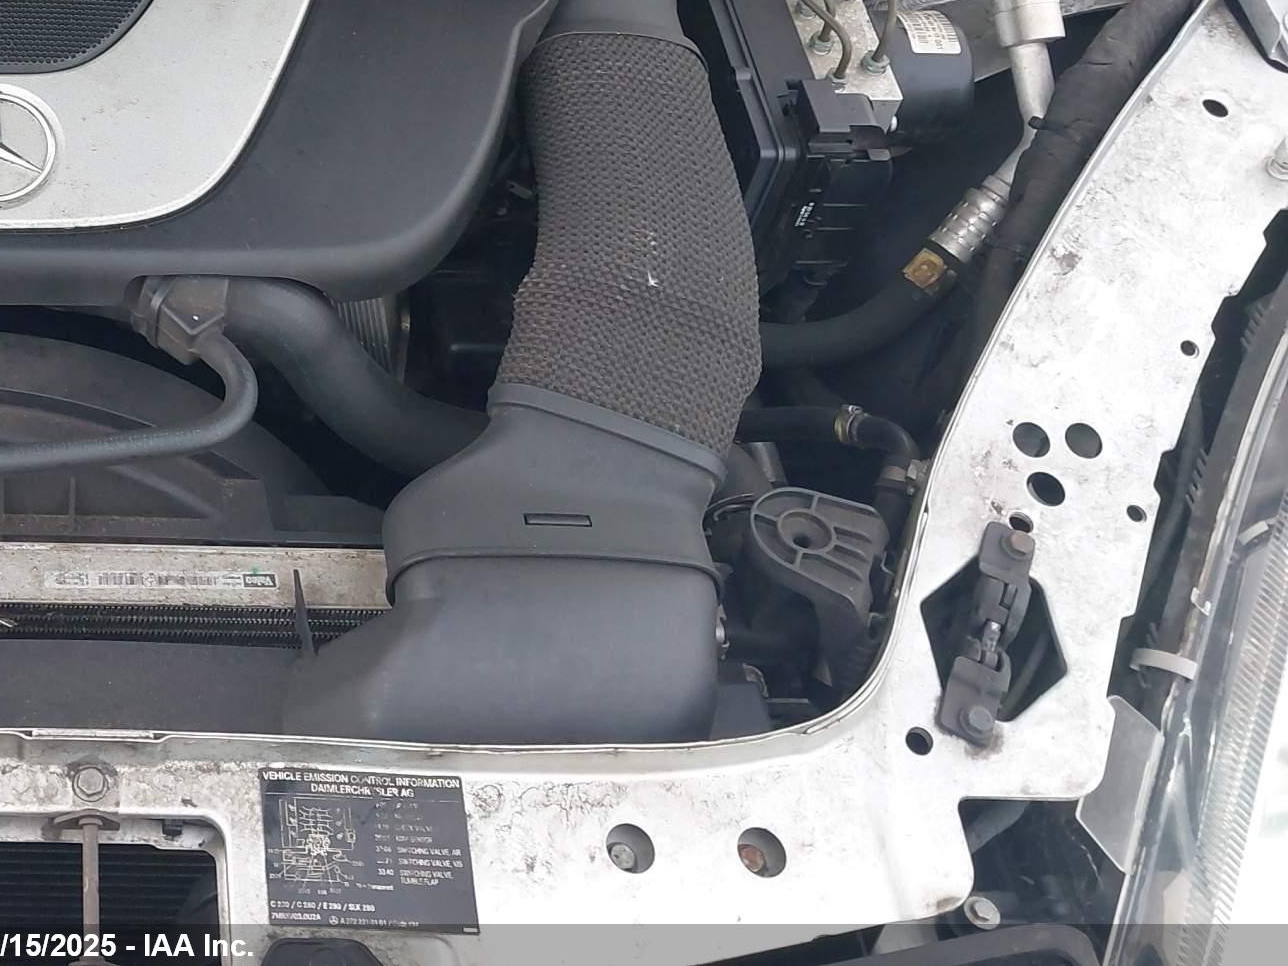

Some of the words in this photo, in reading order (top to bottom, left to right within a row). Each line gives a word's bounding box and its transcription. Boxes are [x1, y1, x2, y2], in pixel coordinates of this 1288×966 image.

[262, 771, 301, 781] VEHICLE
[304, 773, 348, 783] EMISSION
[396, 778, 460, 788] INFORMATION
